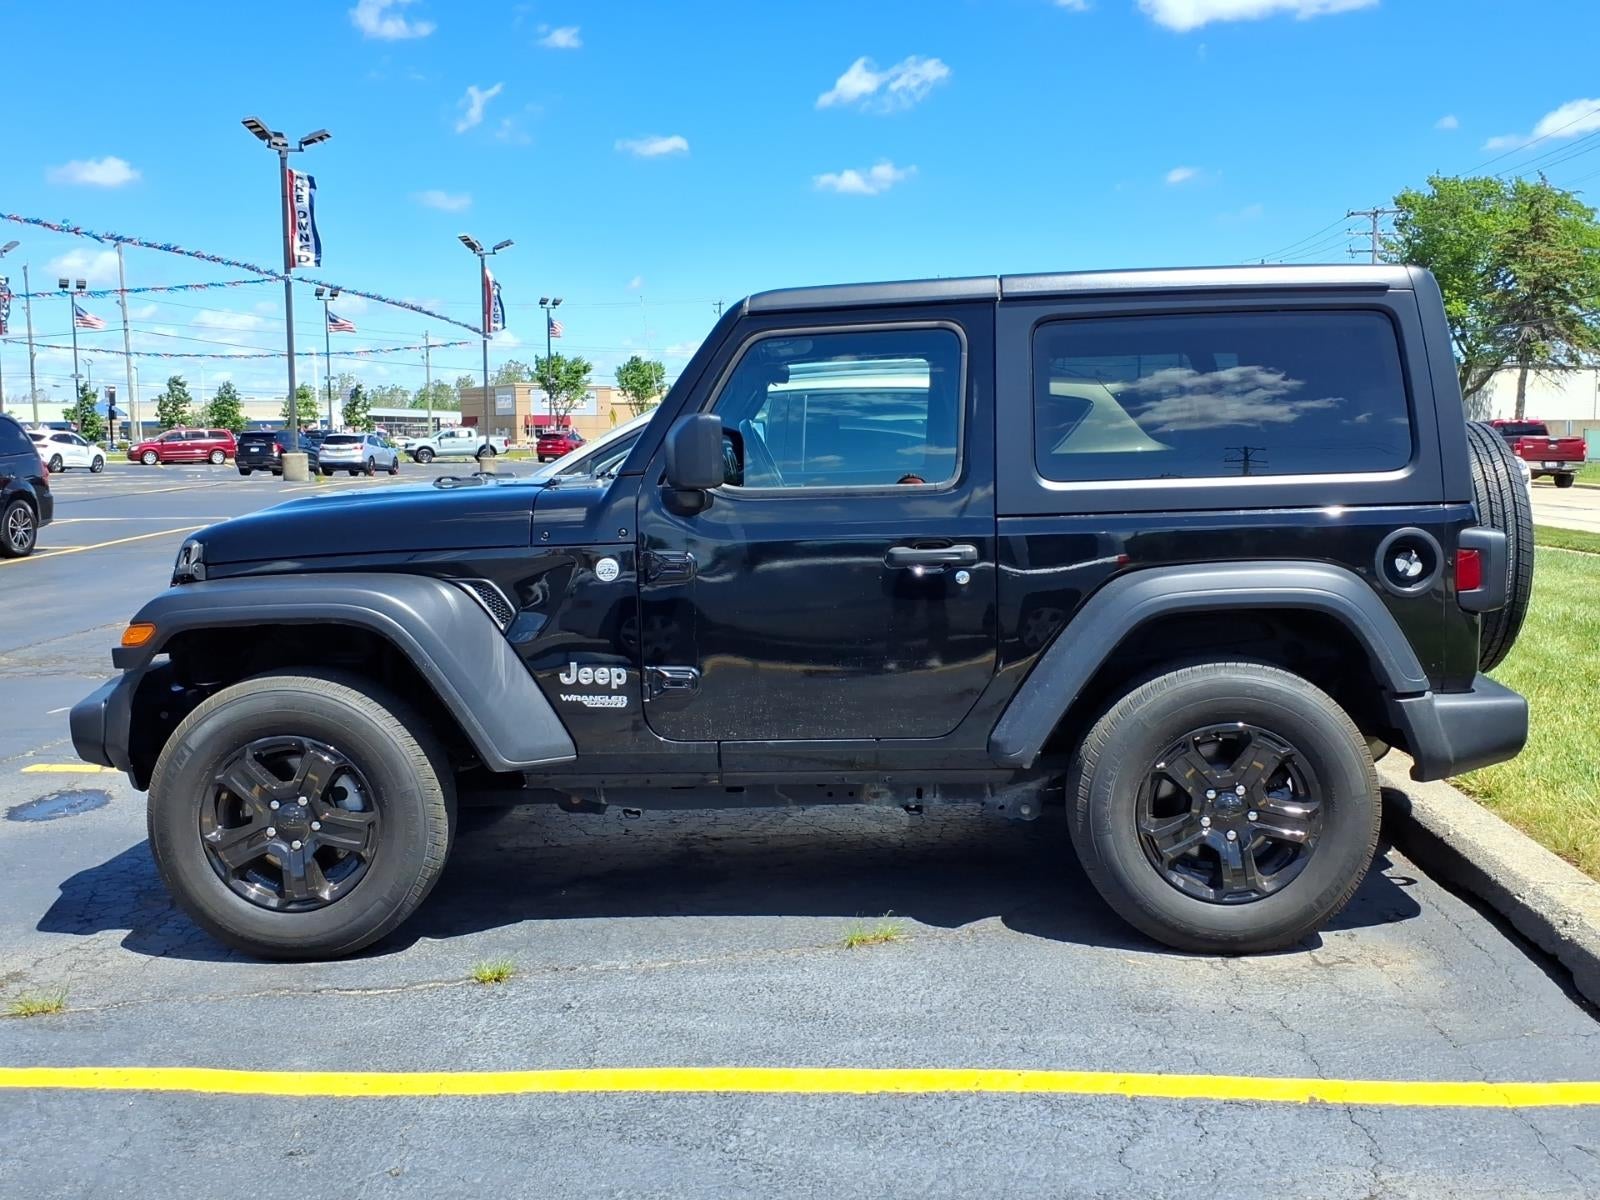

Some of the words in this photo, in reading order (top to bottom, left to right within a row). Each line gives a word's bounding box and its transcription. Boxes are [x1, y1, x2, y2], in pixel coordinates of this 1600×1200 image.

[297, 211, 310, 263] OWNED
[559, 661, 627, 689] Jeep
[559, 694, 628, 702] WRANGLER
